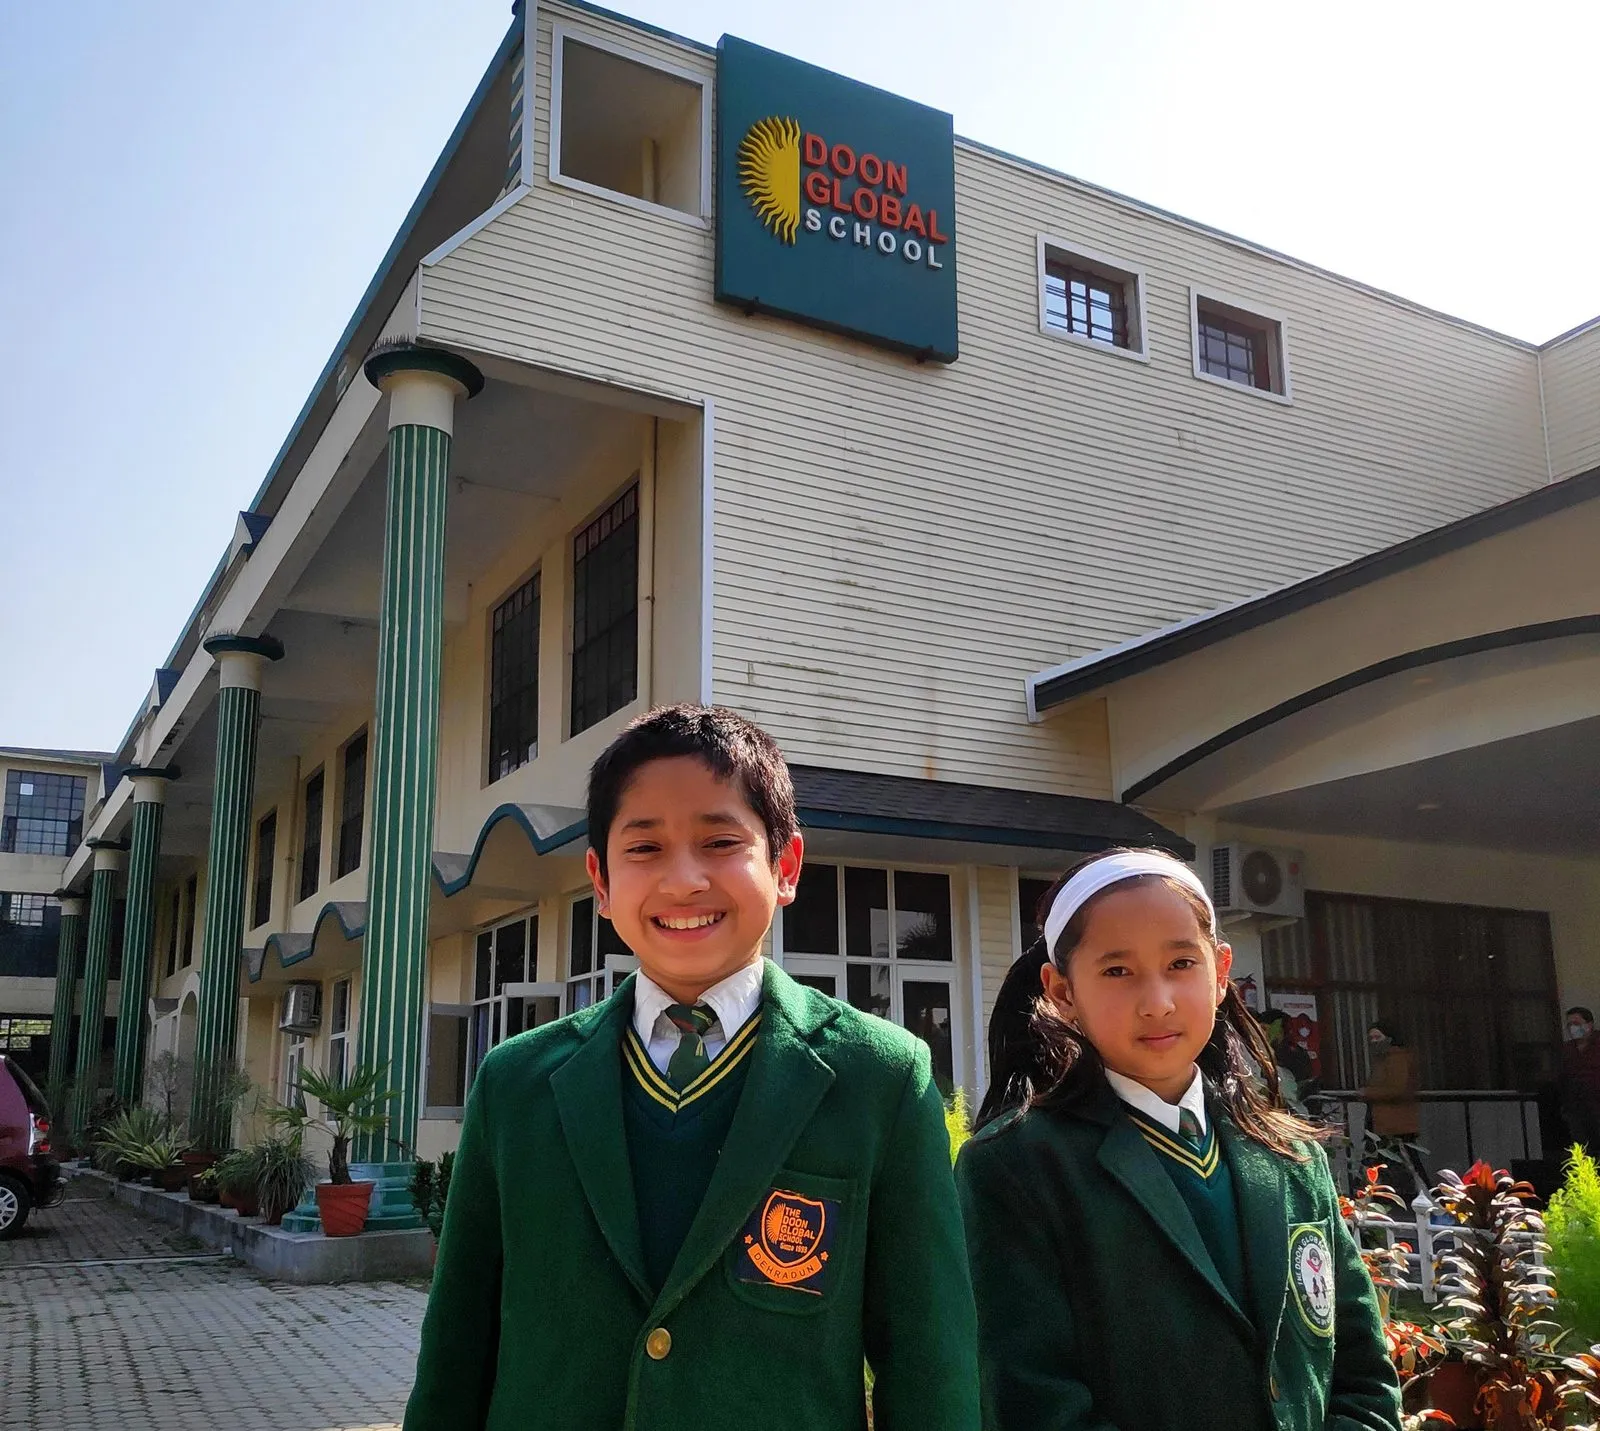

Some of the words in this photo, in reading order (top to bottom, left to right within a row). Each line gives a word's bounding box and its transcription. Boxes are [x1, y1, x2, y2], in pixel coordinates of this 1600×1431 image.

[804, 132, 908, 196] DOON
[805, 172, 948, 243] GLOBAL
[804, 208, 943, 270] SCHOOL
[783, 1216, 808, 1228] DOON
[785, 1207, 801, 1218] THE
[778, 1234, 802, 1244] SCHOOL
[780, 1225, 815, 1240] GLOBAL
[754, 1252, 814, 1279] DEHRADUN
